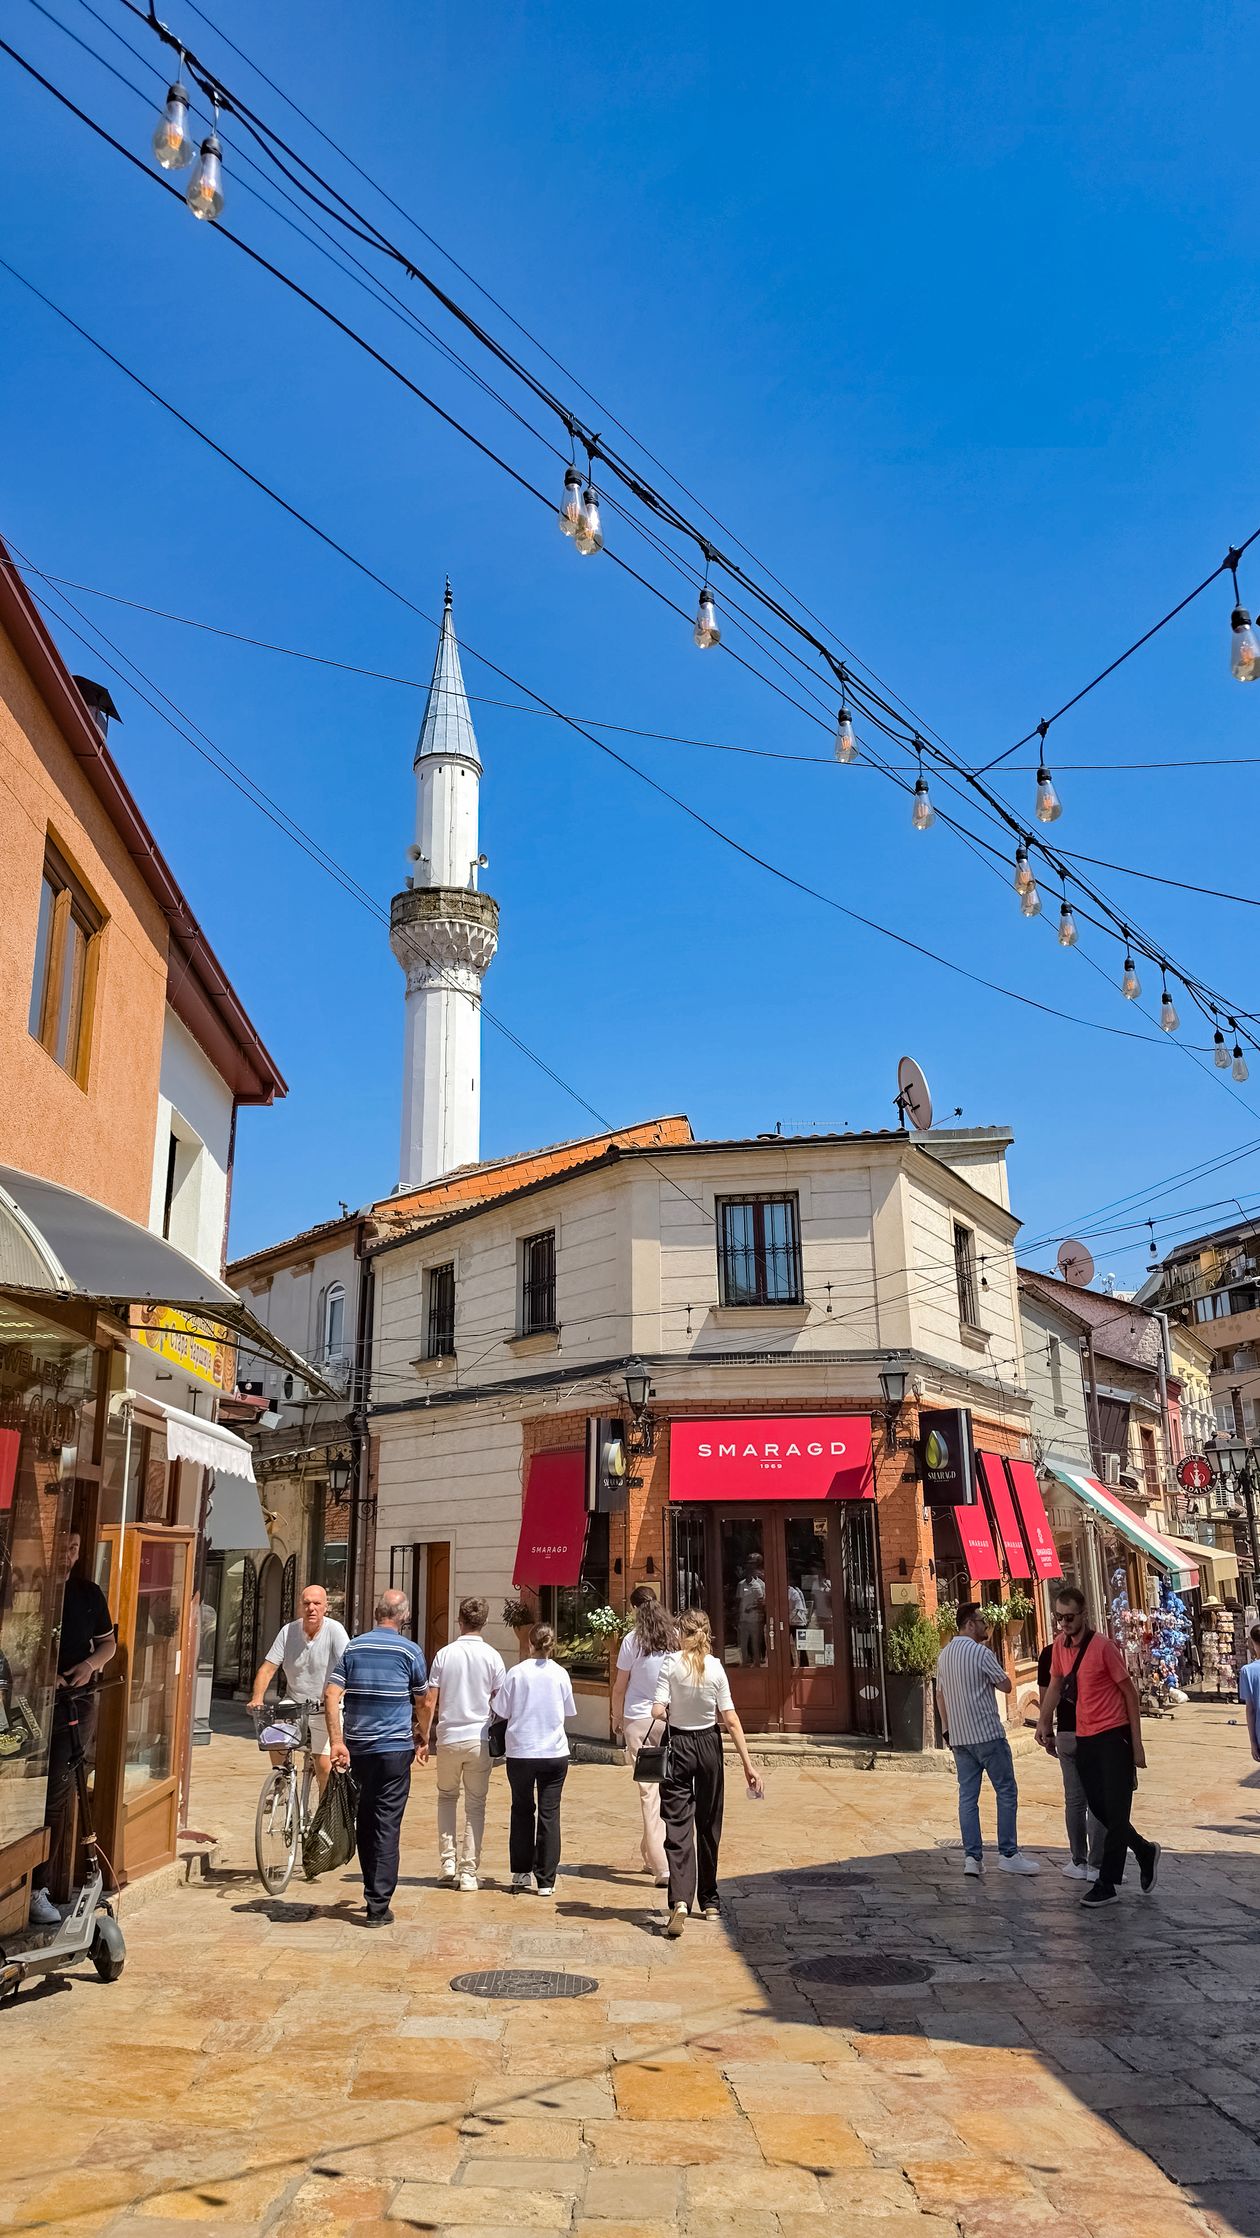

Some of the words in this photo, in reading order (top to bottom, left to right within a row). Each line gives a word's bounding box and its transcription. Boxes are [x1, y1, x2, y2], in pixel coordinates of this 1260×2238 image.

[698, 1442, 846, 1457] SMARAGD
[927, 1470, 957, 1480] SMARAGD
[531, 1545, 568, 1554] SMARAGD
